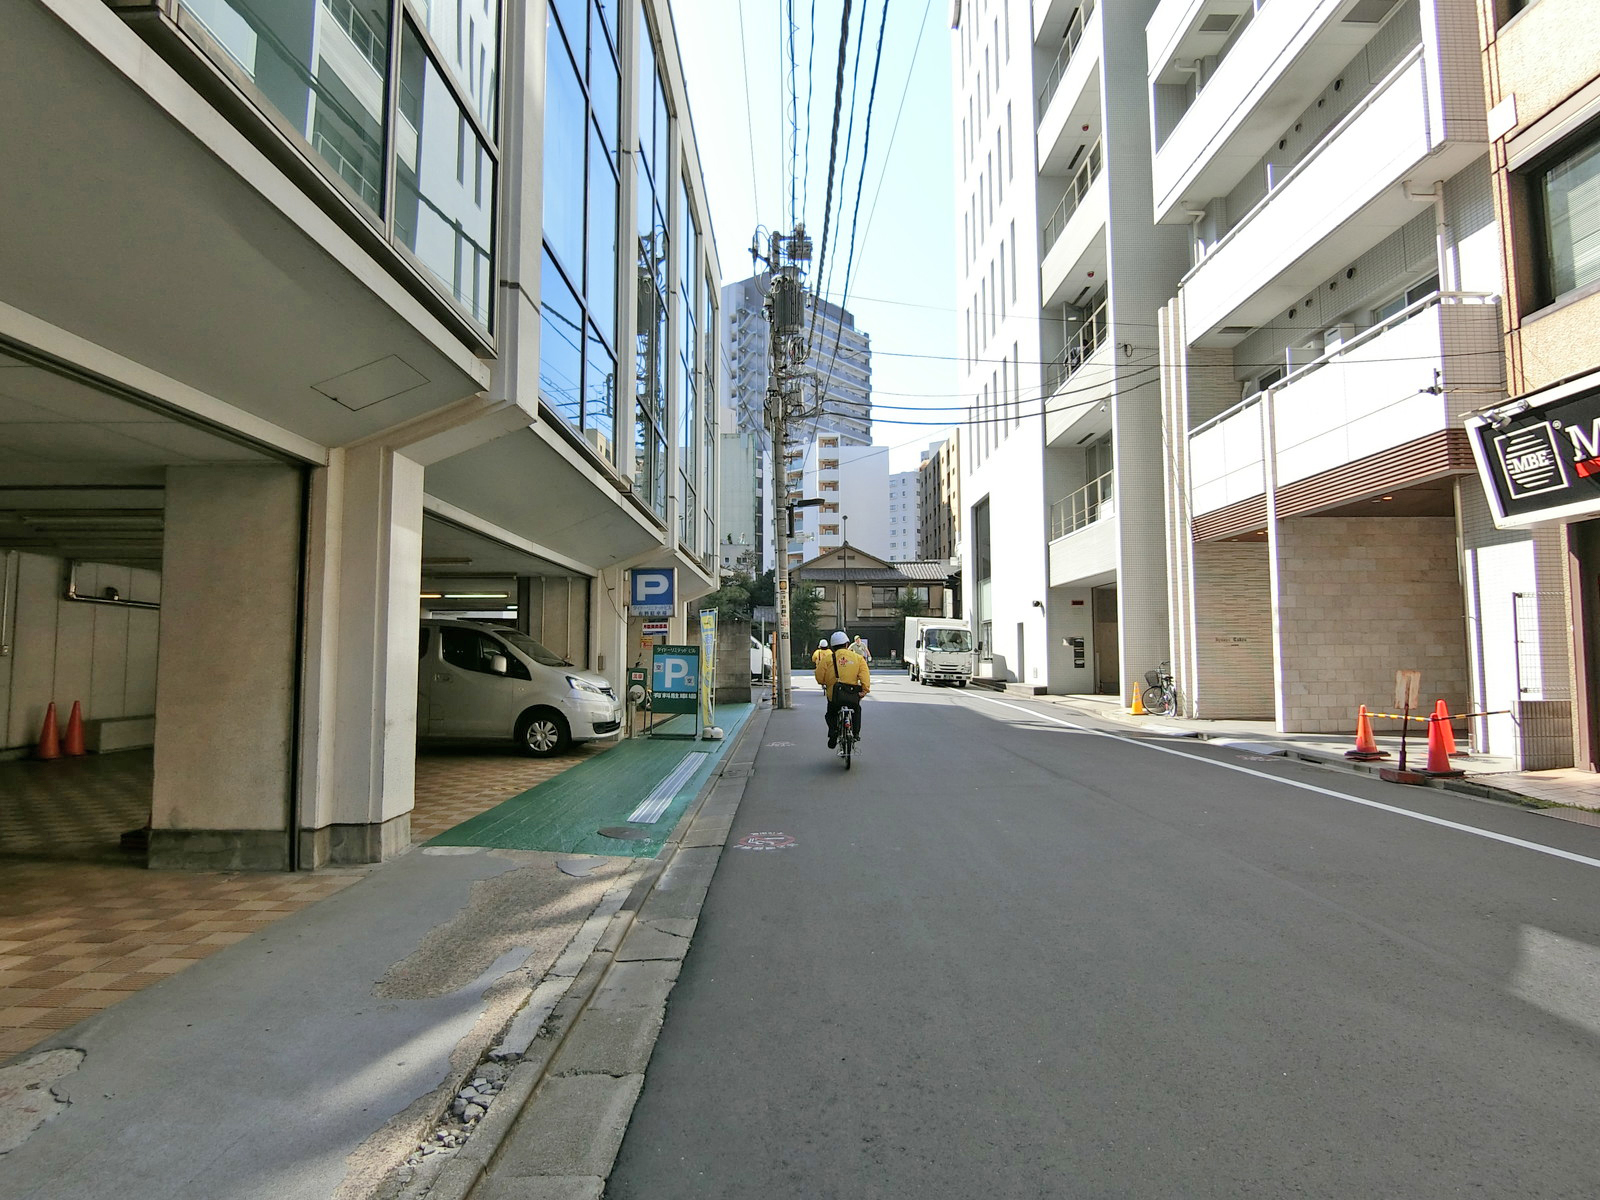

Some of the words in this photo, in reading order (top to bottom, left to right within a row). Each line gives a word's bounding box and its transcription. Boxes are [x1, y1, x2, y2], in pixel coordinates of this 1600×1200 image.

[1512, 450, 1549, 473] MBE
[636, 574, 669, 601] P
[665, 658, 689, 688] P
